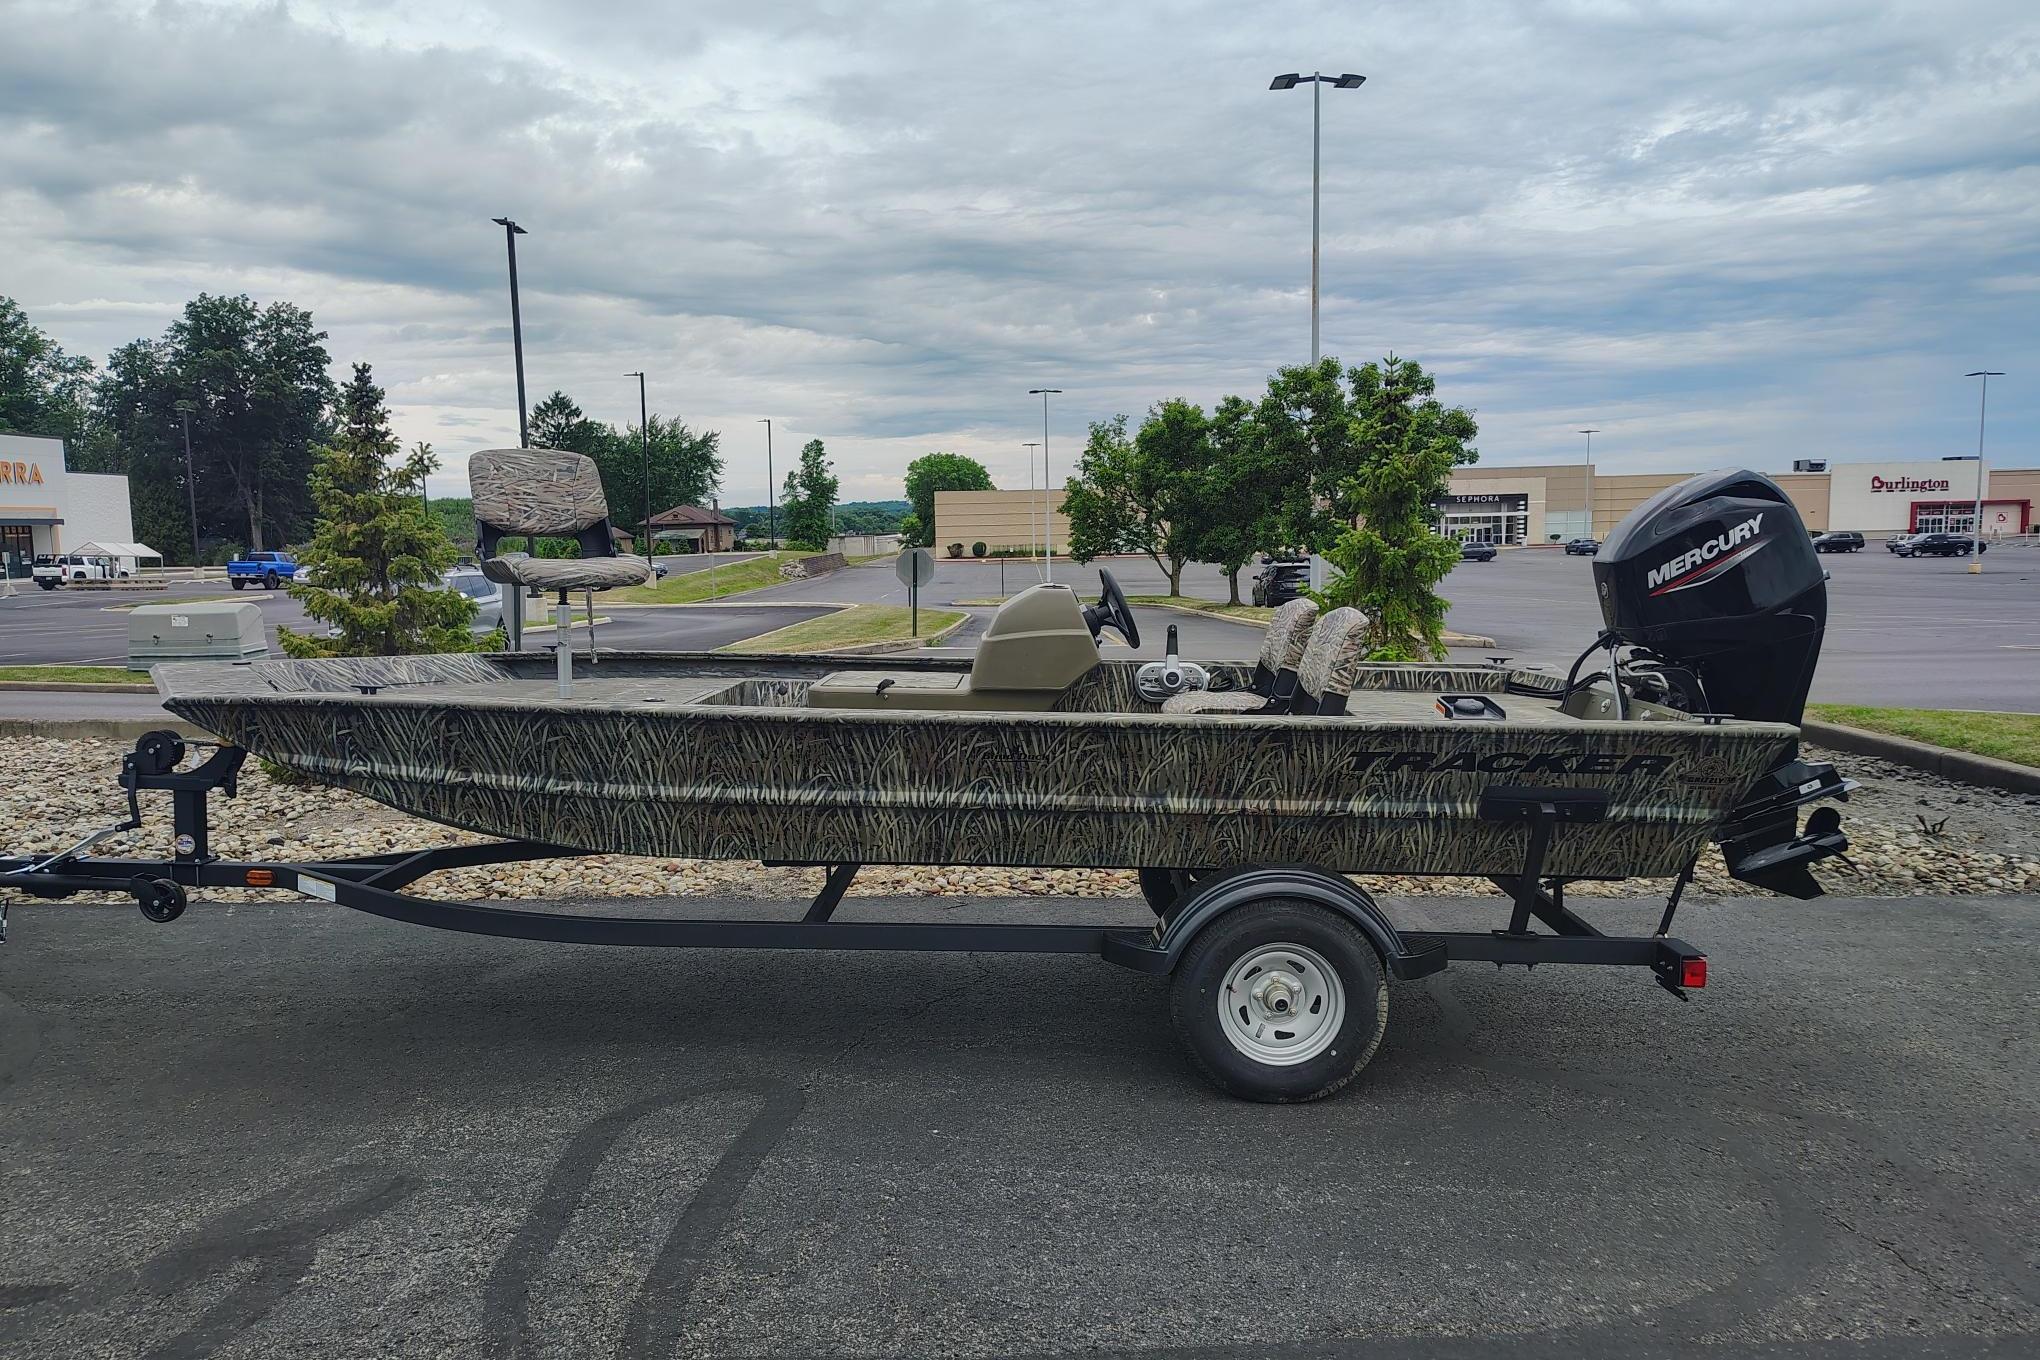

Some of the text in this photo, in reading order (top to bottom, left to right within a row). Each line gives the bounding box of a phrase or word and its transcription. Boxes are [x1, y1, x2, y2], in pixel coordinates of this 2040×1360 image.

[1871, 476, 1949, 492] Burlington
[1456, 495, 1500, 503] SEPHORA
[1647, 512, 1764, 589] MERCURY
[1350, 751, 1674, 775] TRACKER
